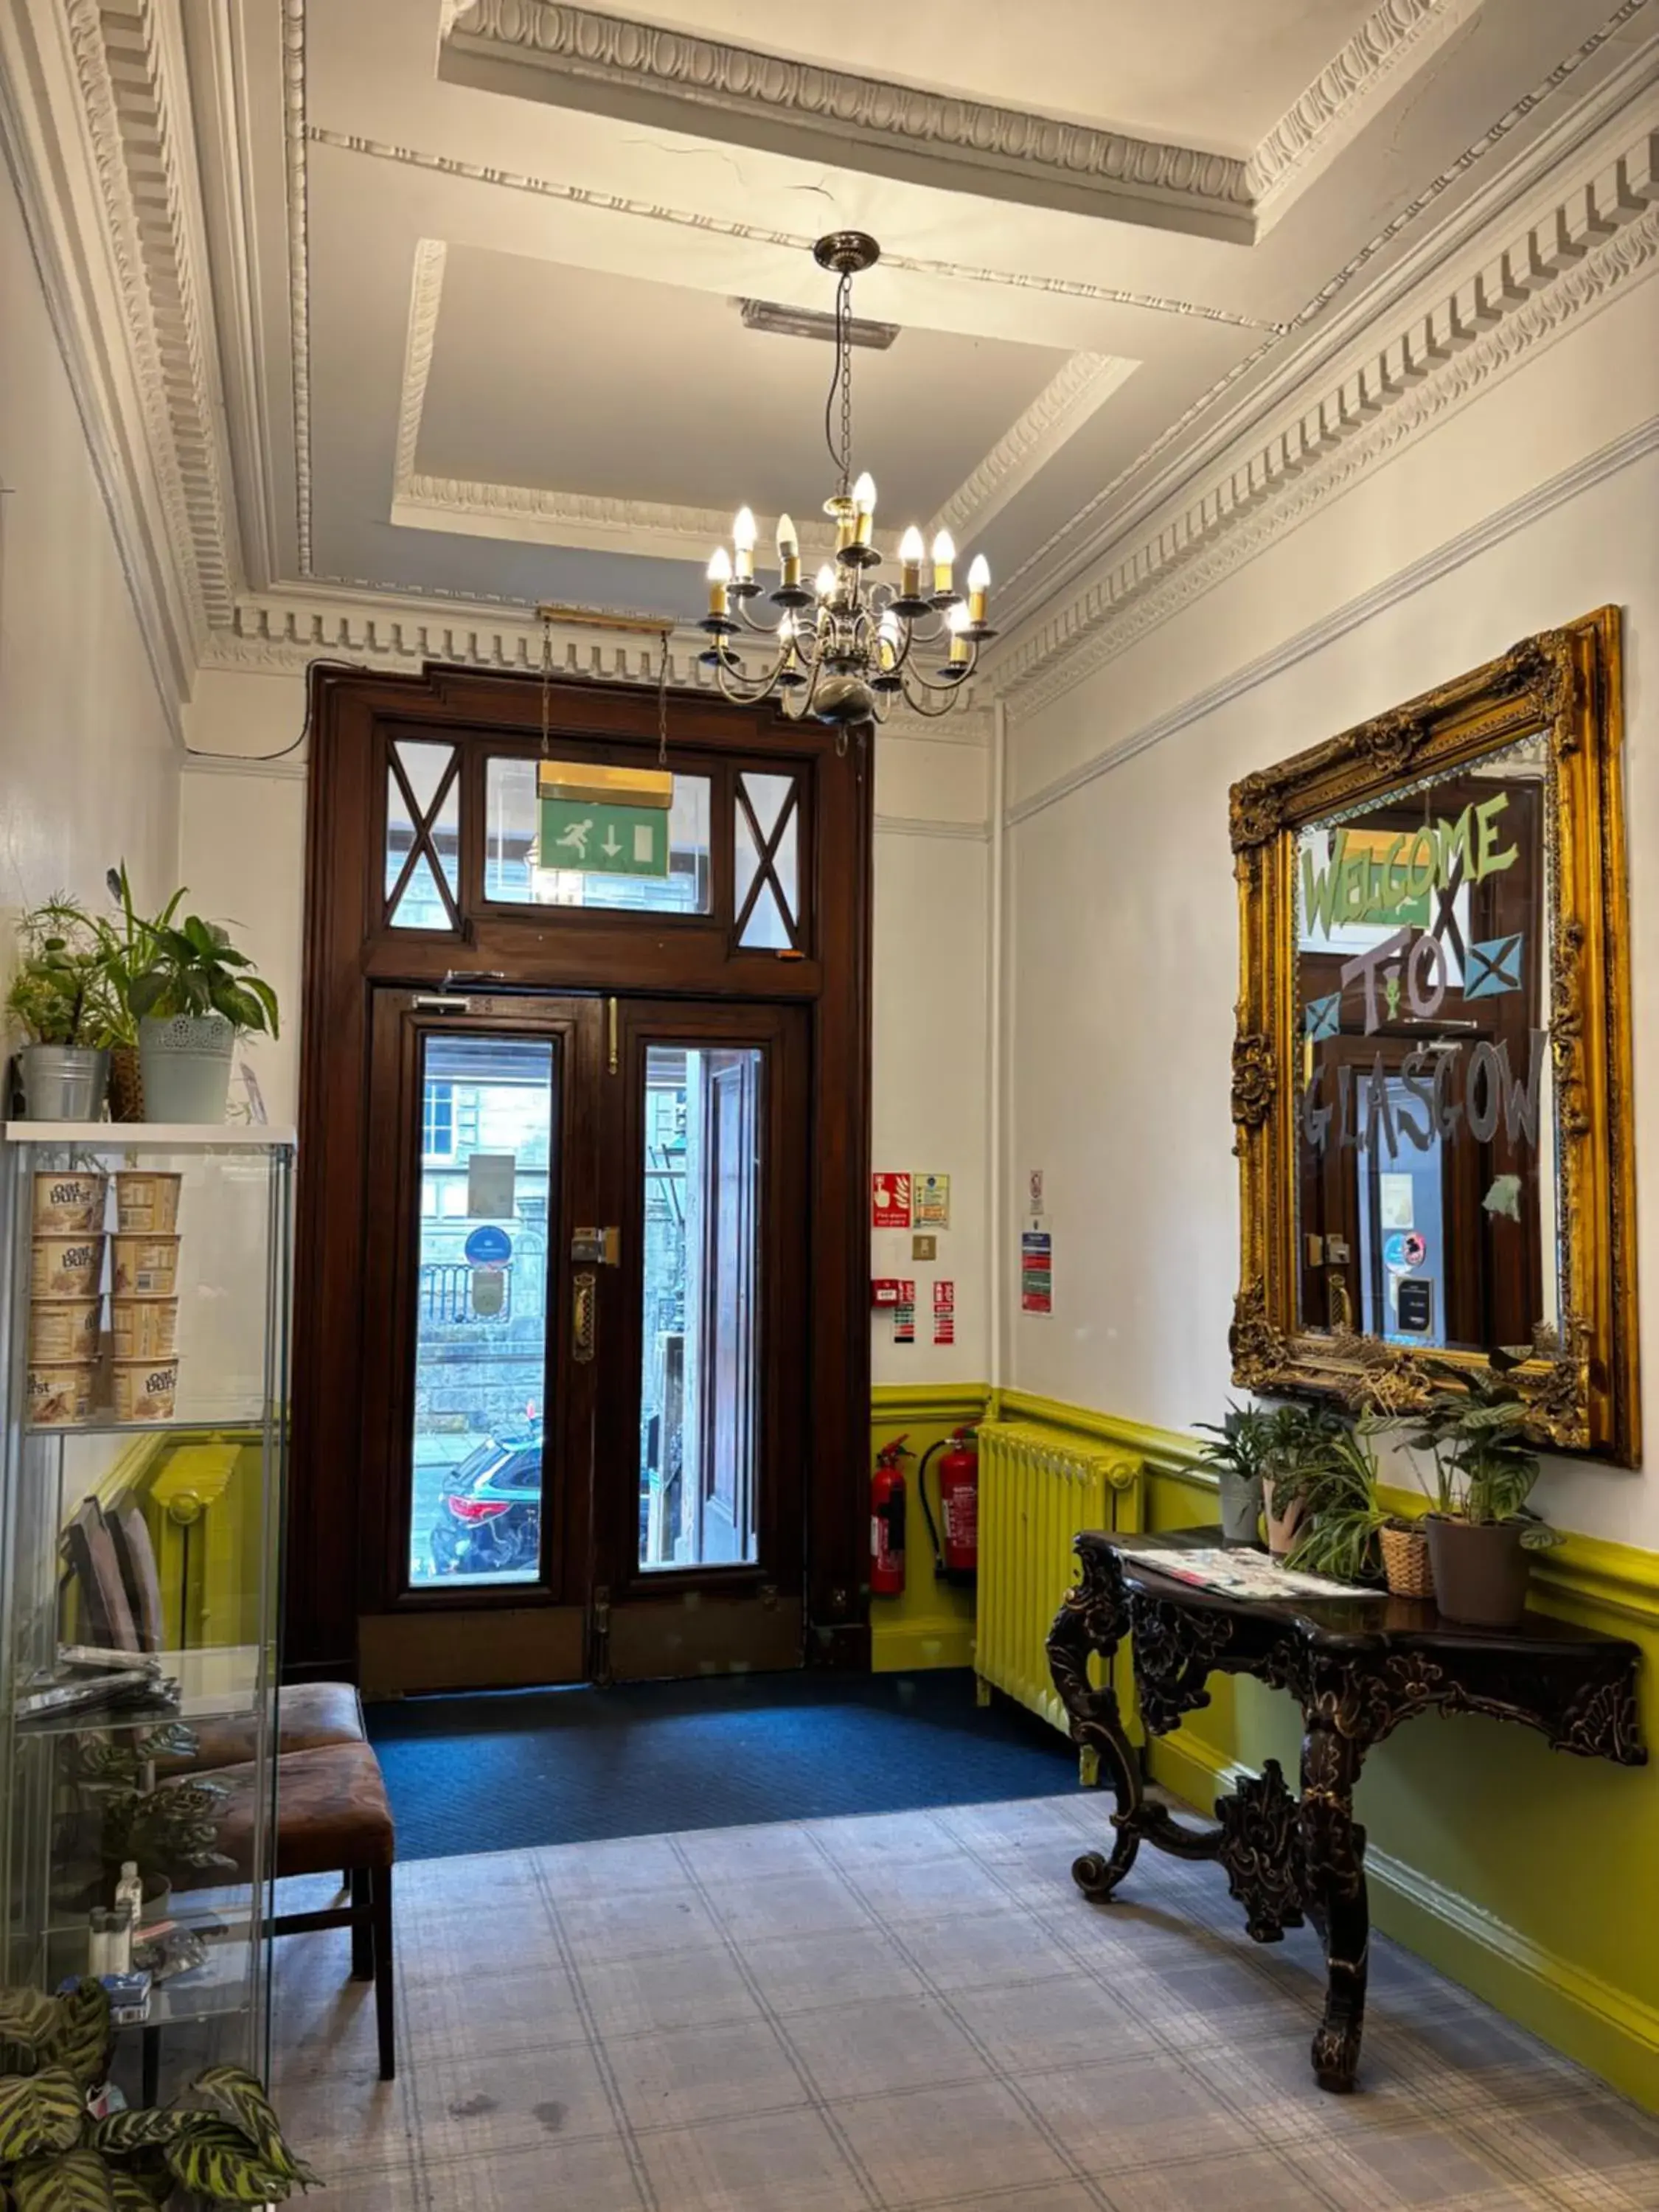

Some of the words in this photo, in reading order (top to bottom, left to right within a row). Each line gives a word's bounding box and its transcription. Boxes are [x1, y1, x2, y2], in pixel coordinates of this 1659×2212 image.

[1301, 792, 1520, 942] WELCOME
[1340, 924, 1447, 1036] TO
[1301, 1029, 1549, 1158] GLASGOW
